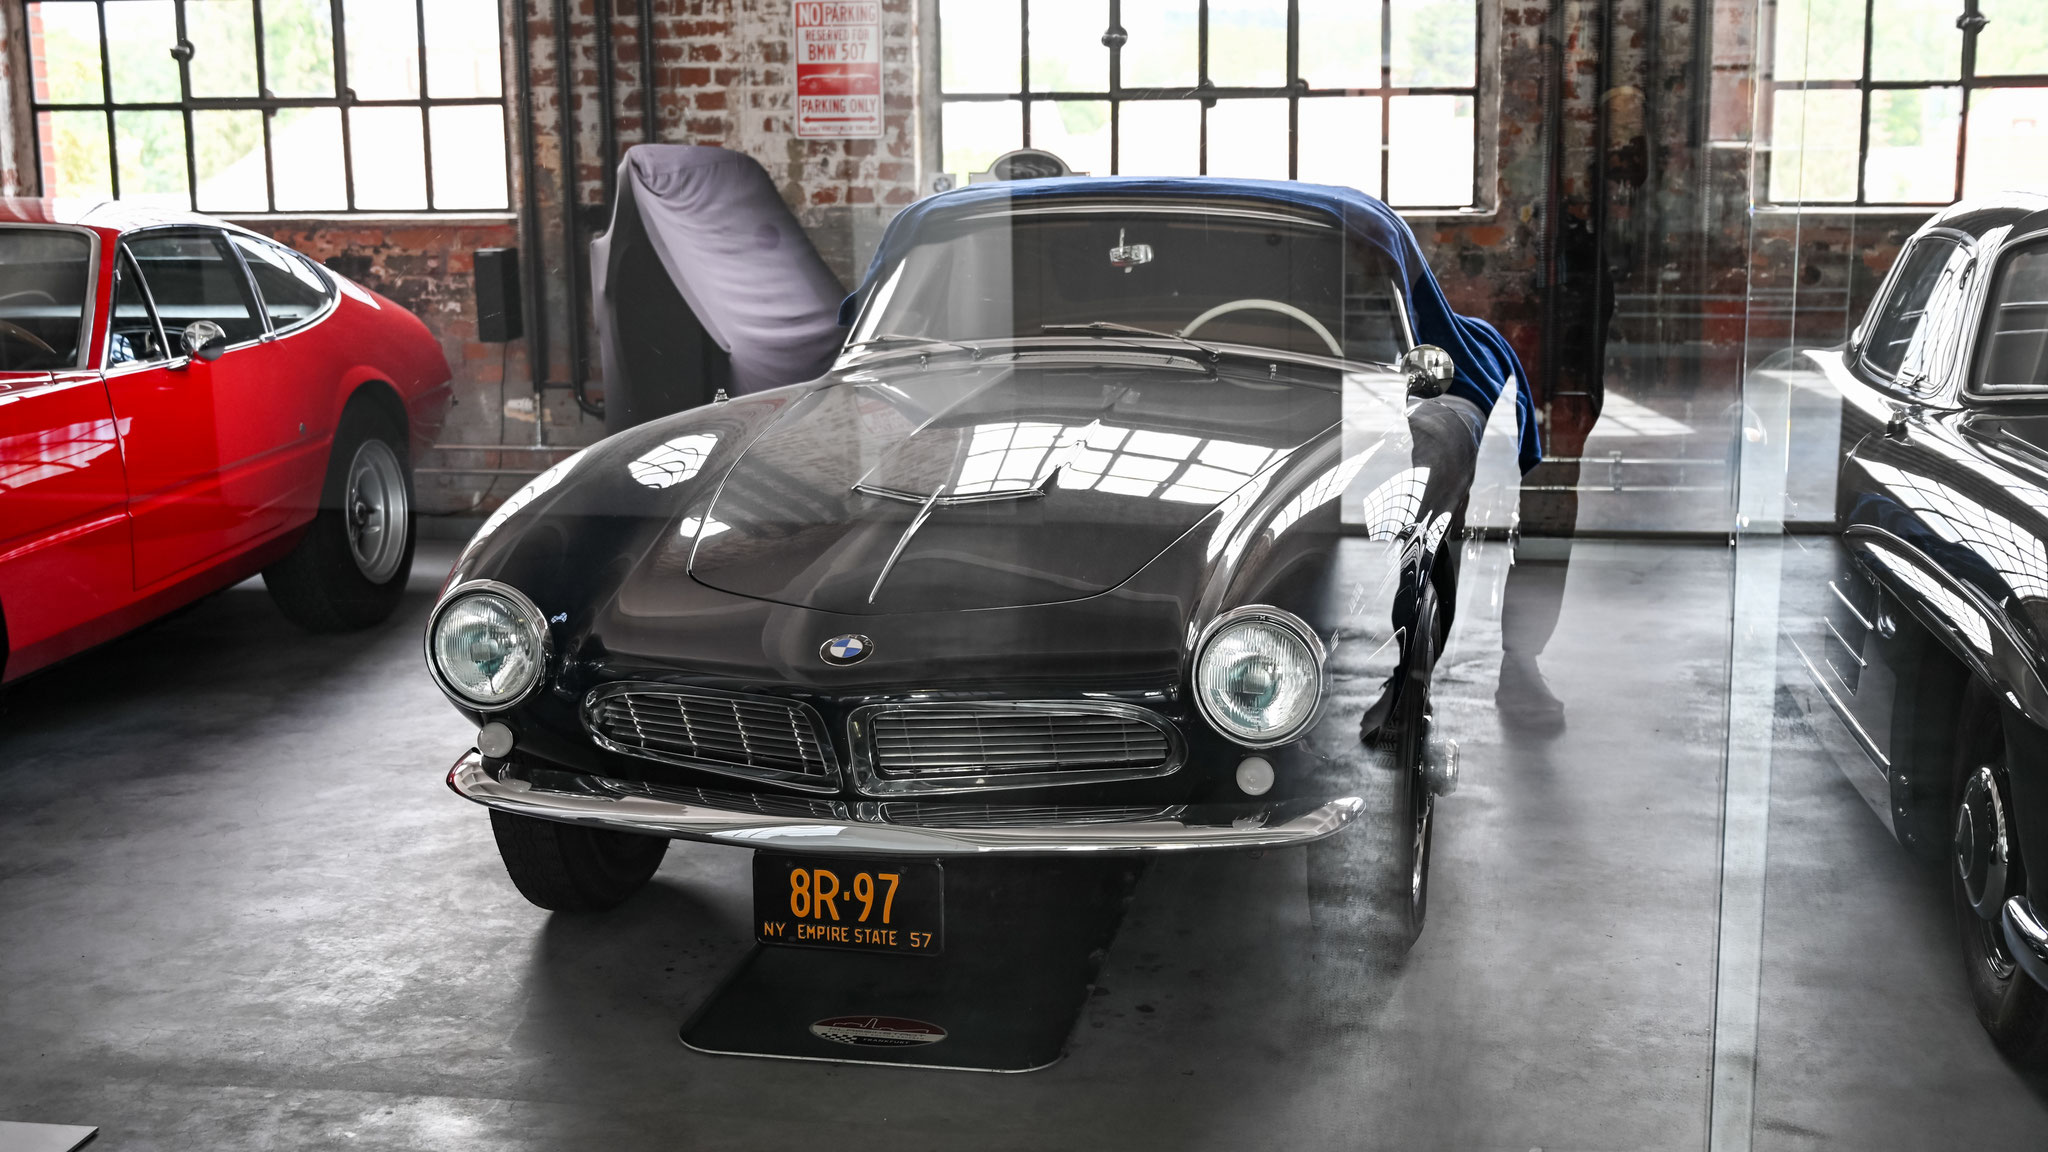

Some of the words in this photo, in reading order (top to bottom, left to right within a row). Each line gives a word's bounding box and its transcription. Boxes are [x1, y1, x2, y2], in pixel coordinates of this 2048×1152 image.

[799, 3, 821, 26] NO
[825, 5, 876, 22] PARKING
[806, 29, 849, 42] RESERVED
[852, 29, 870, 41] FOR
[808, 43, 837, 61] BMW
[841, 43, 867, 60] 507
[801, 99, 846, 113] PARKING
[850, 99, 877, 113] ONLY
[764, 922, 787, 937] NY
[797, 924, 850, 943] EMPIRE
[854, 928, 897, 946] STATE
[910, 932, 932, 948] 57
